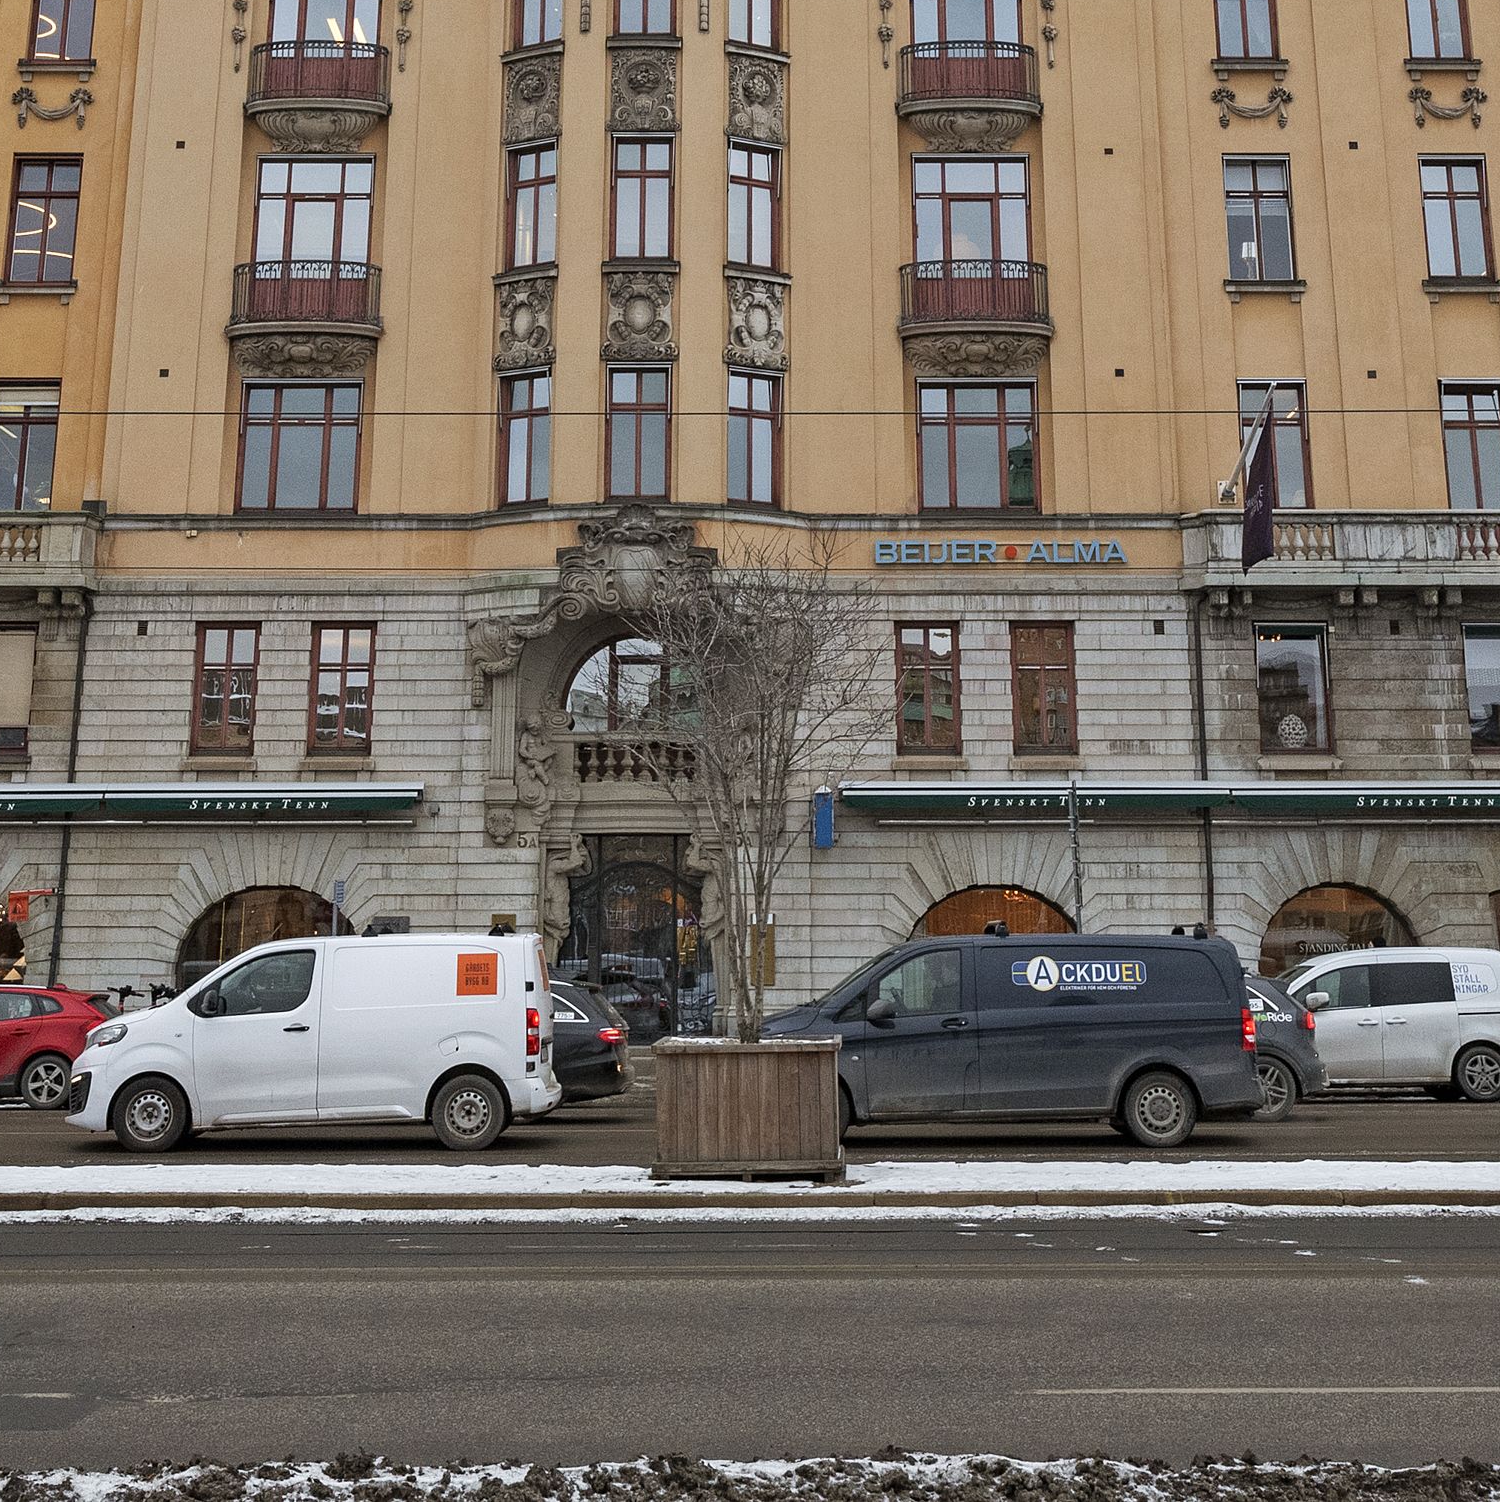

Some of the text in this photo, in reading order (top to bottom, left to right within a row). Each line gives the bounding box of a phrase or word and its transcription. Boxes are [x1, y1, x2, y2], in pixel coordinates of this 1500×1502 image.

[874, 540, 1128, 564] BEIJER ALMA
[189, 798, 329, 809] SVENSKT TENN
[967, 796, 1050, 806] SVENSKT
[1356, 796, 1495, 806] SVENSKT TENN
[1299, 943, 1349, 953] STANDING
[1451, 964, 1469, 974] SYD
[1455, 984, 1489, 994] NINGAR
